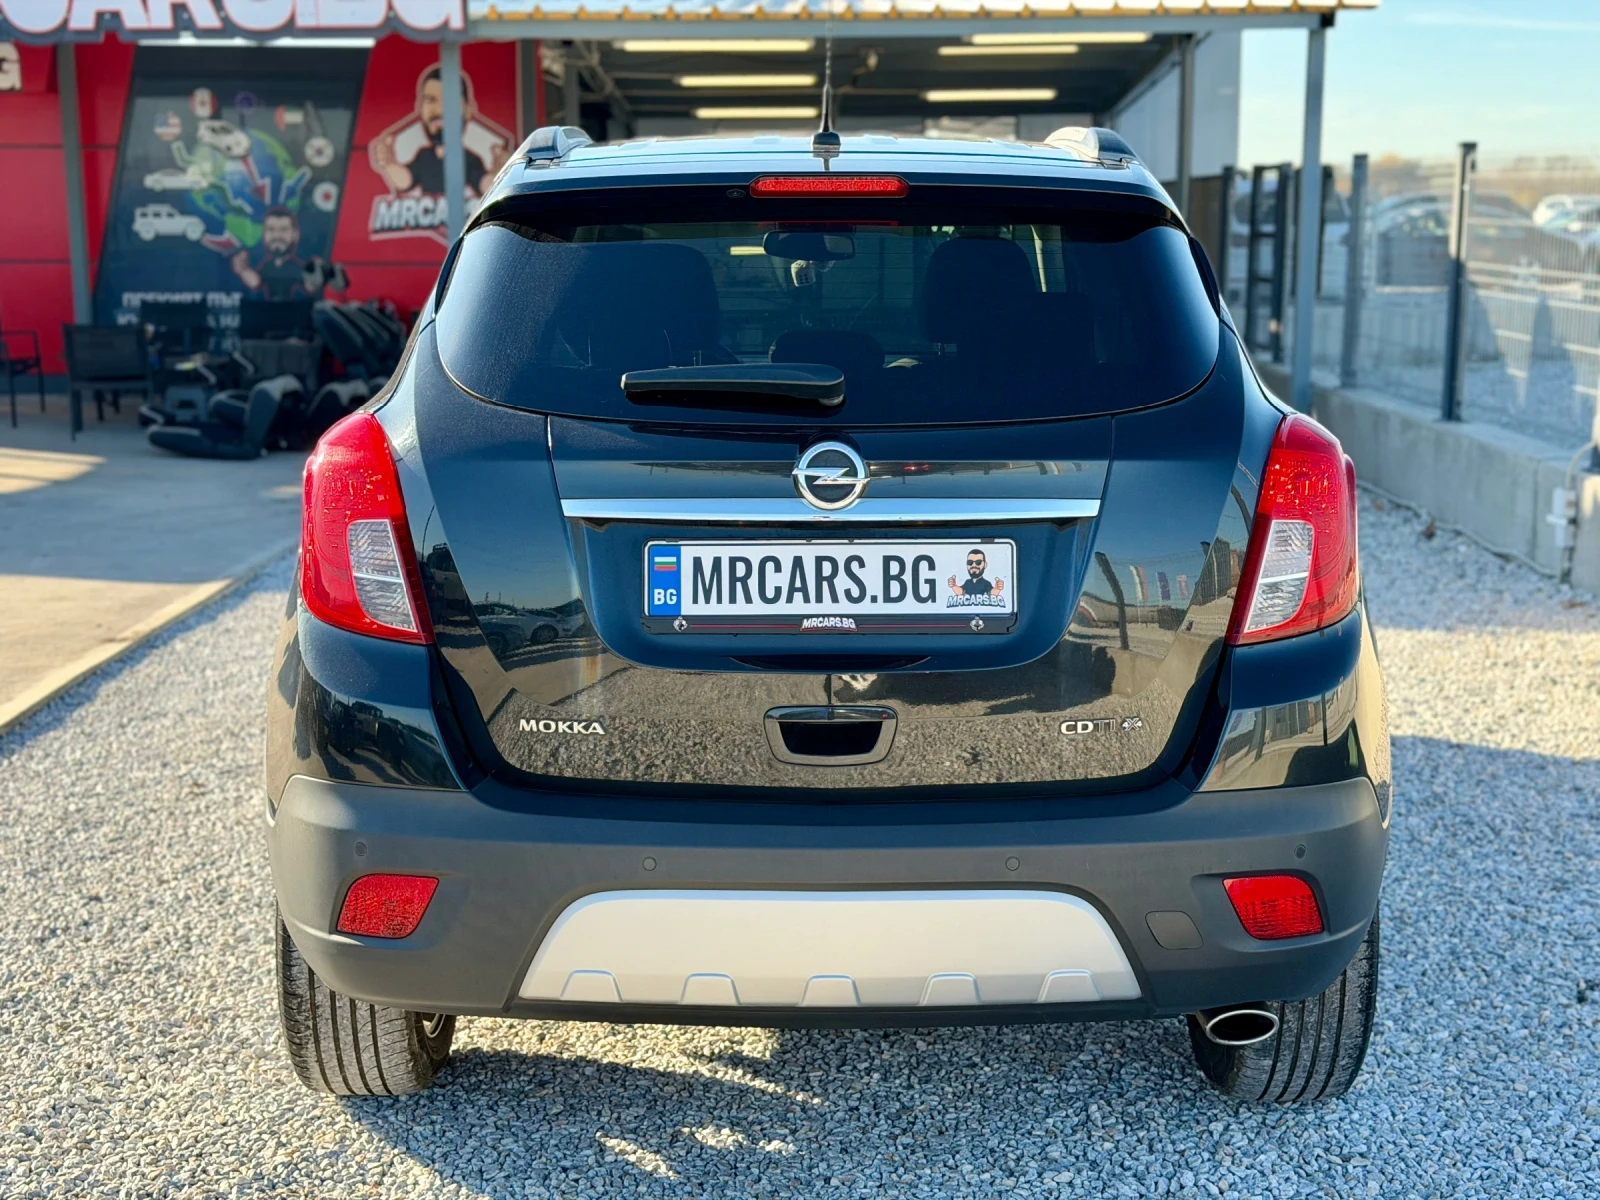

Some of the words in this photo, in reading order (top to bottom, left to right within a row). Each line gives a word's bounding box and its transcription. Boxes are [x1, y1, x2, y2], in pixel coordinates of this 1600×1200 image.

[692, 554, 937, 605] MRCARS.BG
[653, 588, 677, 605] BG
[946, 593, 1006, 608] MRCARS.BG
[802, 616, 857, 630] MRCARS.BG
[519, 718, 606, 735] MOKKA
[1060, 719, 1116, 734] CDTI
